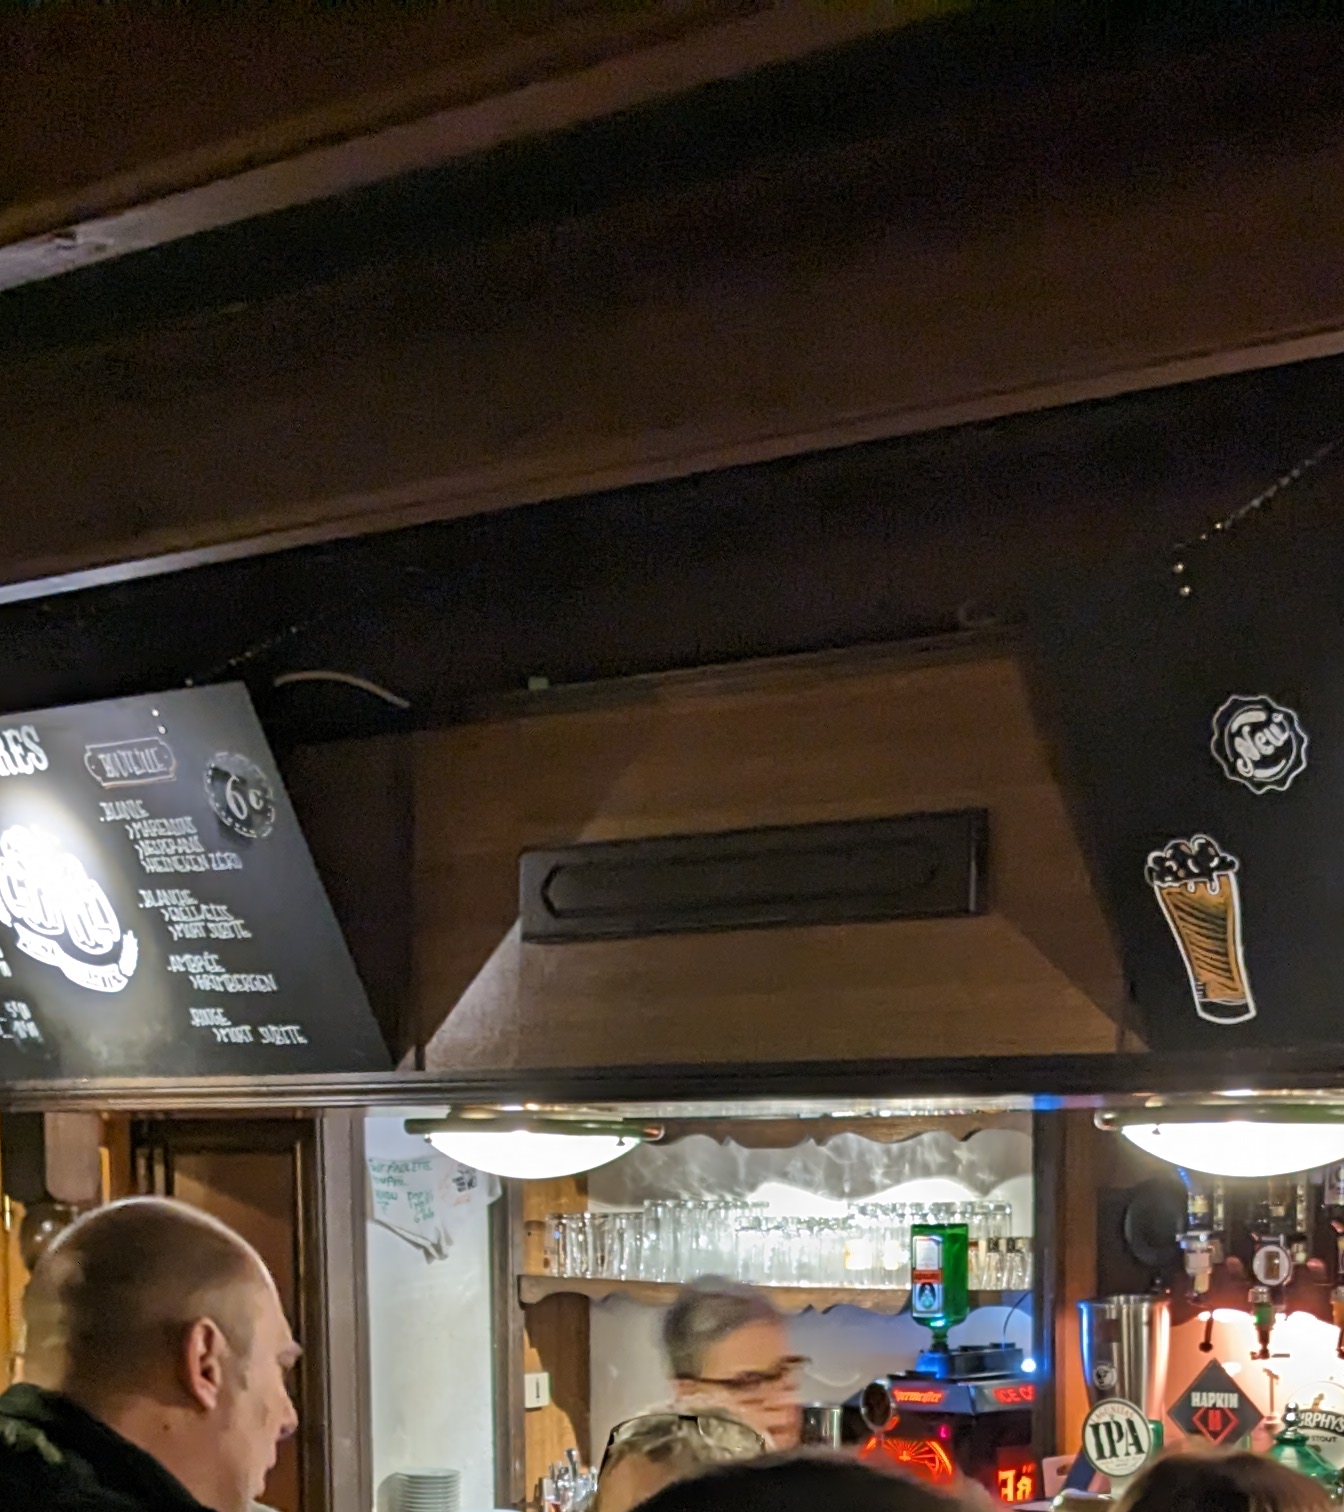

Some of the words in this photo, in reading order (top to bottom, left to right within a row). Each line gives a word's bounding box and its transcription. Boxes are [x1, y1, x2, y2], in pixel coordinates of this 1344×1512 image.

[1191, 1391, 1239, 1409] HAPKIN
[1089, 1418, 1145, 1460] IPA
[1311, 1435, 1338, 1443] STOUT
